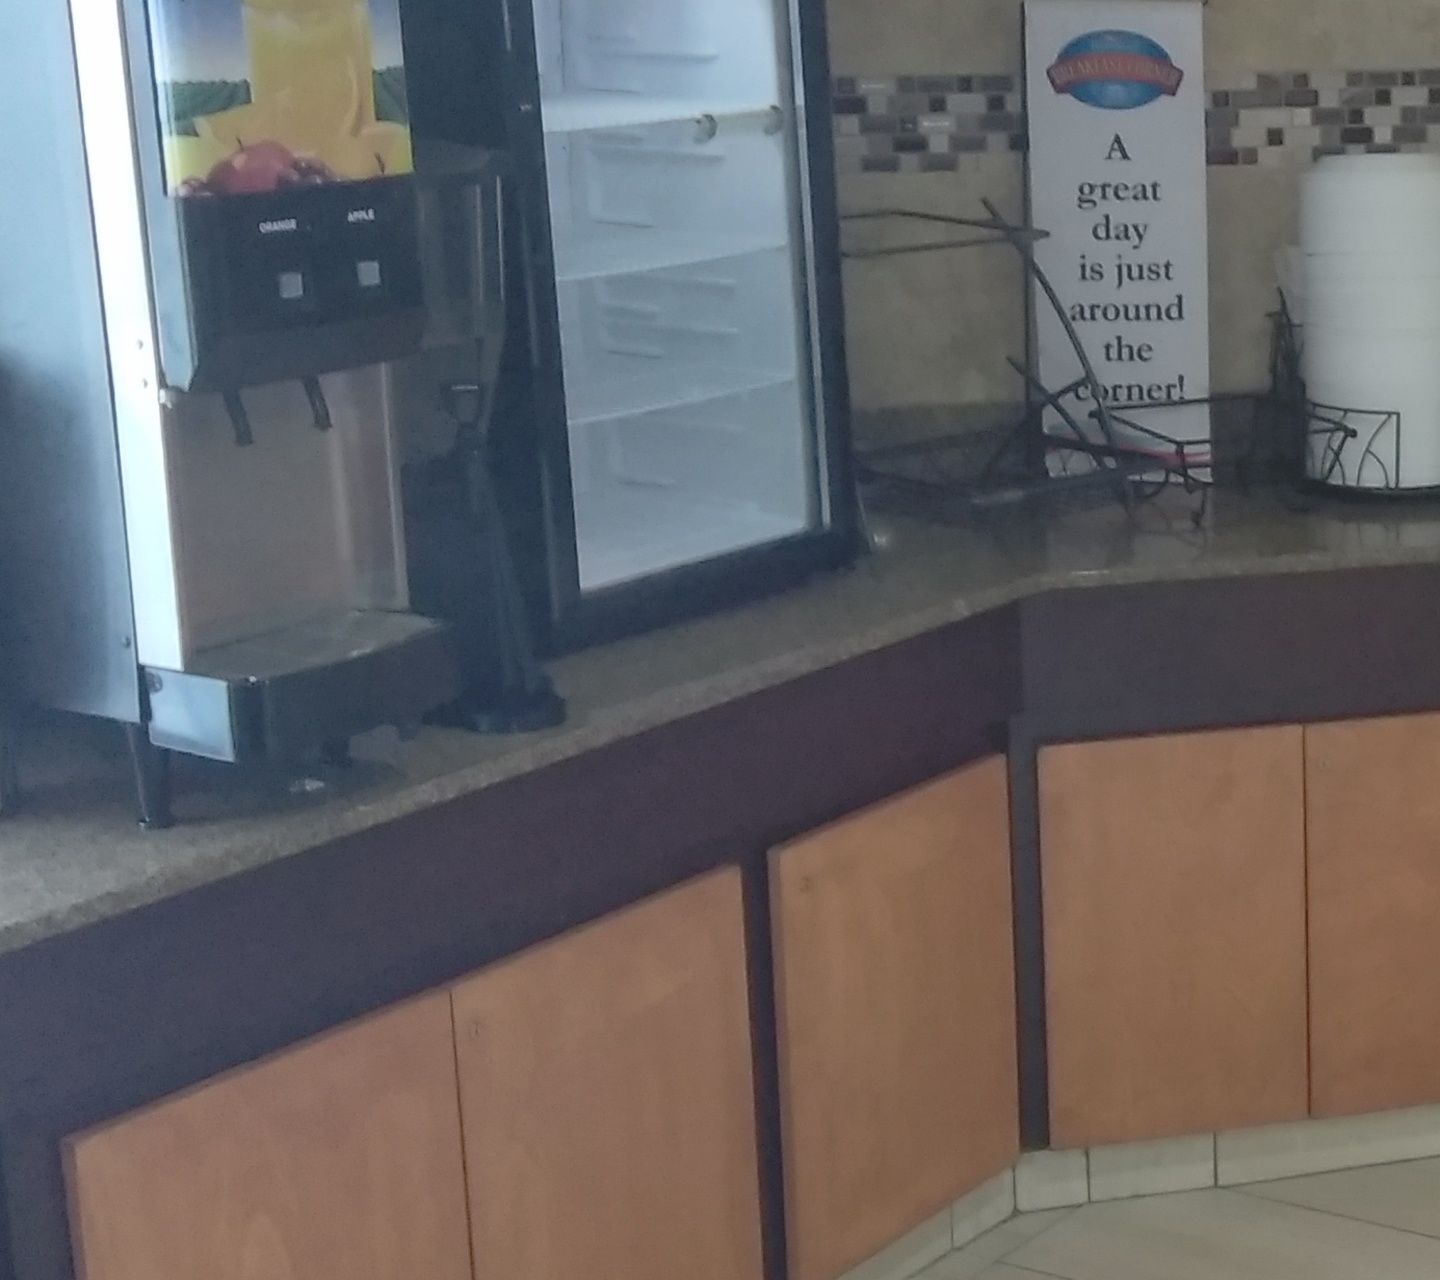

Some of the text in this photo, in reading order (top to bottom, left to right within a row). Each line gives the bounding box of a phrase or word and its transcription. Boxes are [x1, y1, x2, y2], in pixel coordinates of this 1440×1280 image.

[1105, 133, 1132, 161] A
[1077, 181, 1161, 210] great
[259, 218, 297, 234] ORANGE
[347, 208, 375, 223] APPLE
[1091, 213, 1148, 250] day
[1079, 254, 1174, 289] is just
[1070, 294, 1184, 322] around
[1103, 335, 1153, 362] the
